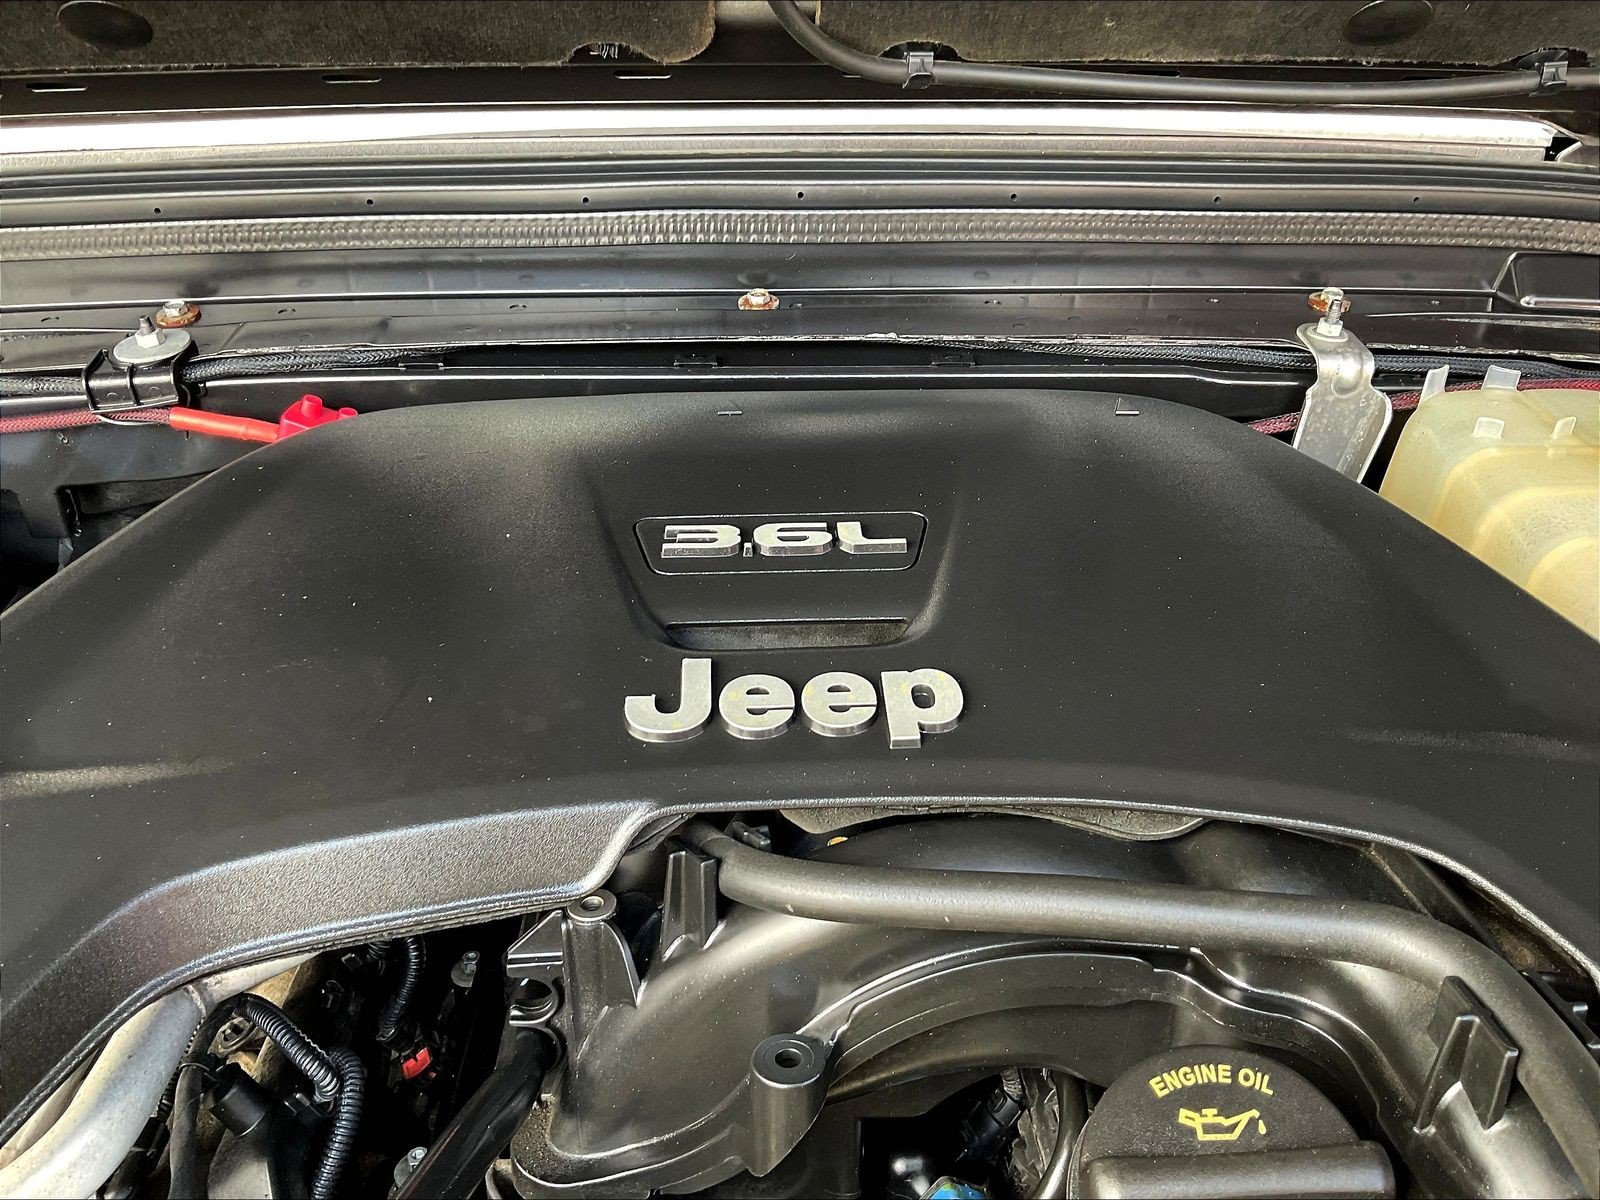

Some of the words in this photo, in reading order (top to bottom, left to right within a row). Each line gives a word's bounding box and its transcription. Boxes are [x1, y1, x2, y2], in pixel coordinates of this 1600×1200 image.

[661, 522, 907, 558] 3.6L
[625, 658, 963, 749] Jeep
[1149, 1064, 1232, 1098] ENGINE
[1238, 1067, 1273, 1095] OIL
